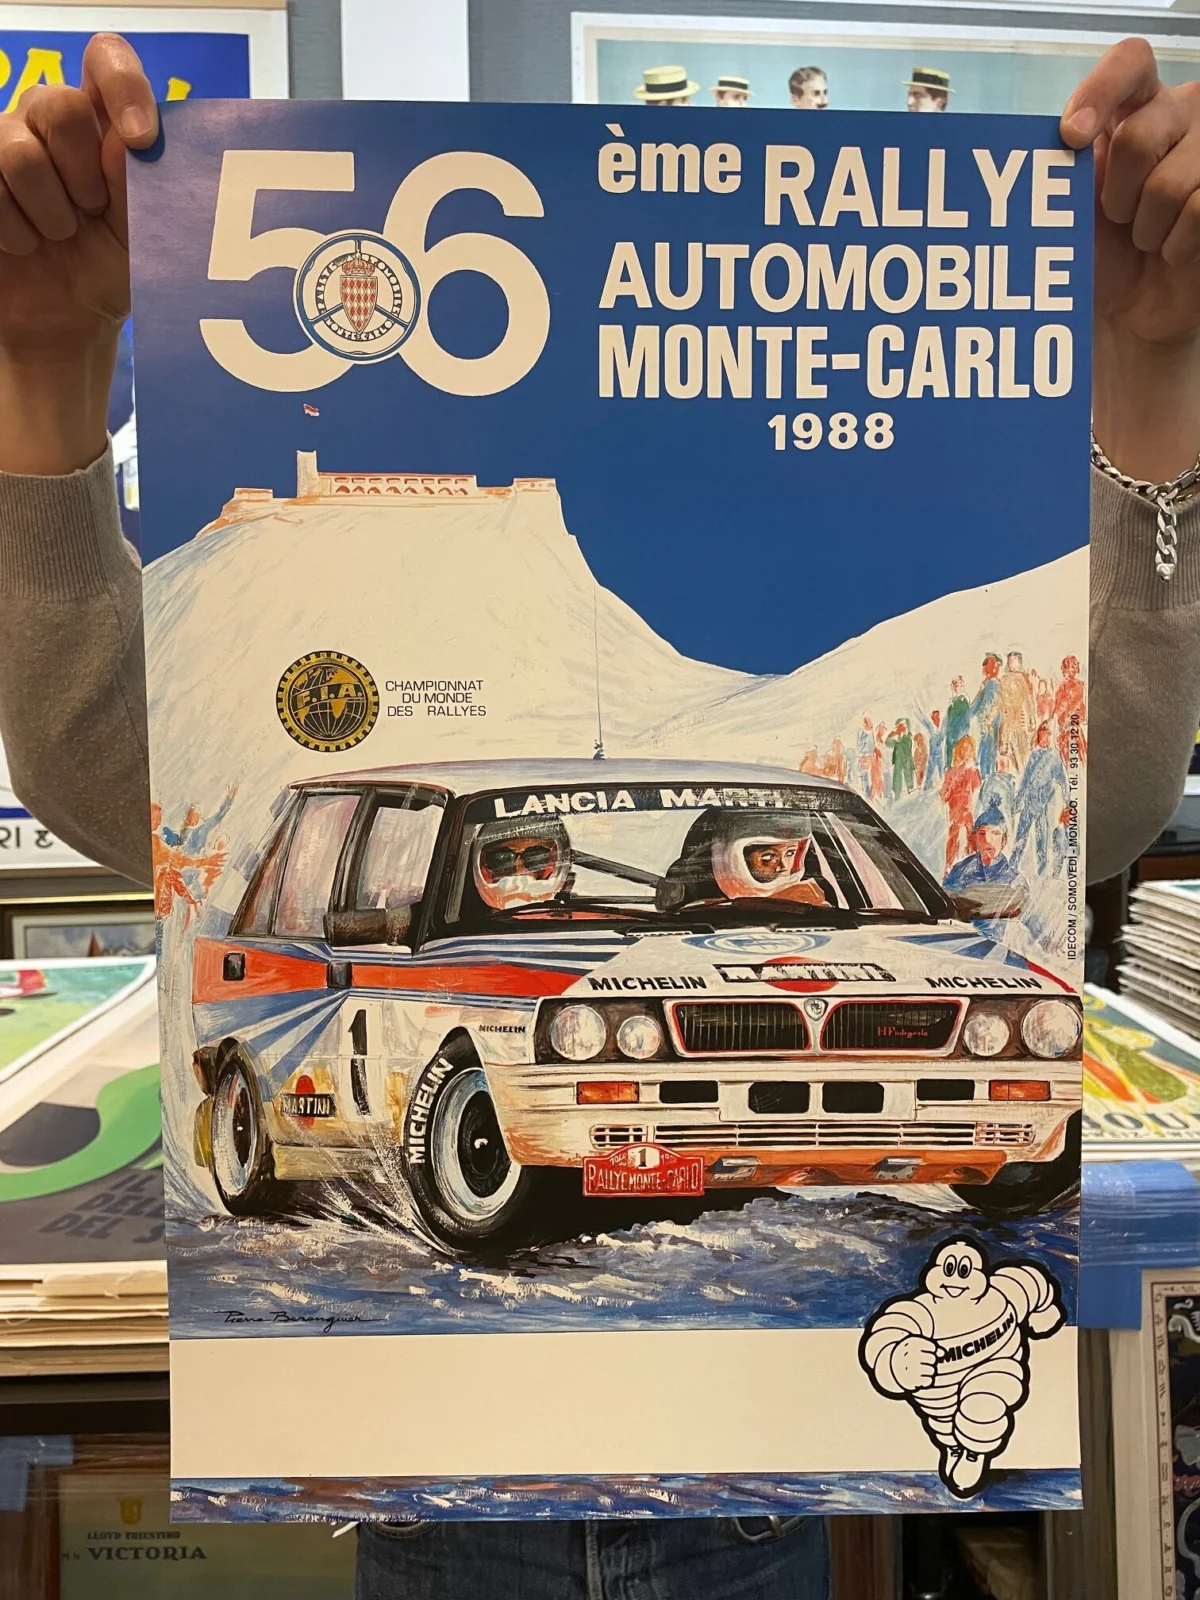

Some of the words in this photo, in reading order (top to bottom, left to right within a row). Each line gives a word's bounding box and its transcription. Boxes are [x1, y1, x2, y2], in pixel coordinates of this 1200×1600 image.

[598, 124, 741, 193] ème
[765, 145, 1075, 227] RALLYE
[200, 150, 551, 397] 56
[599, 242, 1074, 313] AUTOMOBILE
[599, 324, 1073, 399] MONTE-CARLO
[768, 412, 894, 450] 1988
[385, 680, 484, 692] CHAMPIONNAT
[402, 692, 421, 704] DU
[424, 692, 472, 703] MONDE
[387, 705, 413, 717] DES
[427, 705, 487, 717] RALLYES
[1070, 728, 1079, 740] 12
[1070, 743, 1079, 754] 30
[1070, 757, 1079, 769] 93
[494, 789, 635, 819] LANCIA
[1067, 919, 1077, 960] IDECOM
[591, 976, 707, 991] MICHELIN
[926, 977, 1042, 991] MICHELIN
[479, 1024, 526, 1034] MICHELIN
[348, 1009, 372, 1116] 1
[409, 1057, 454, 1165] MICHELIN
[637, 1148, 648, 1168] 1
[937, 1311, 1015, 1364] MICHELIN
[87, 1545, 207, 1562] VICTORIA
